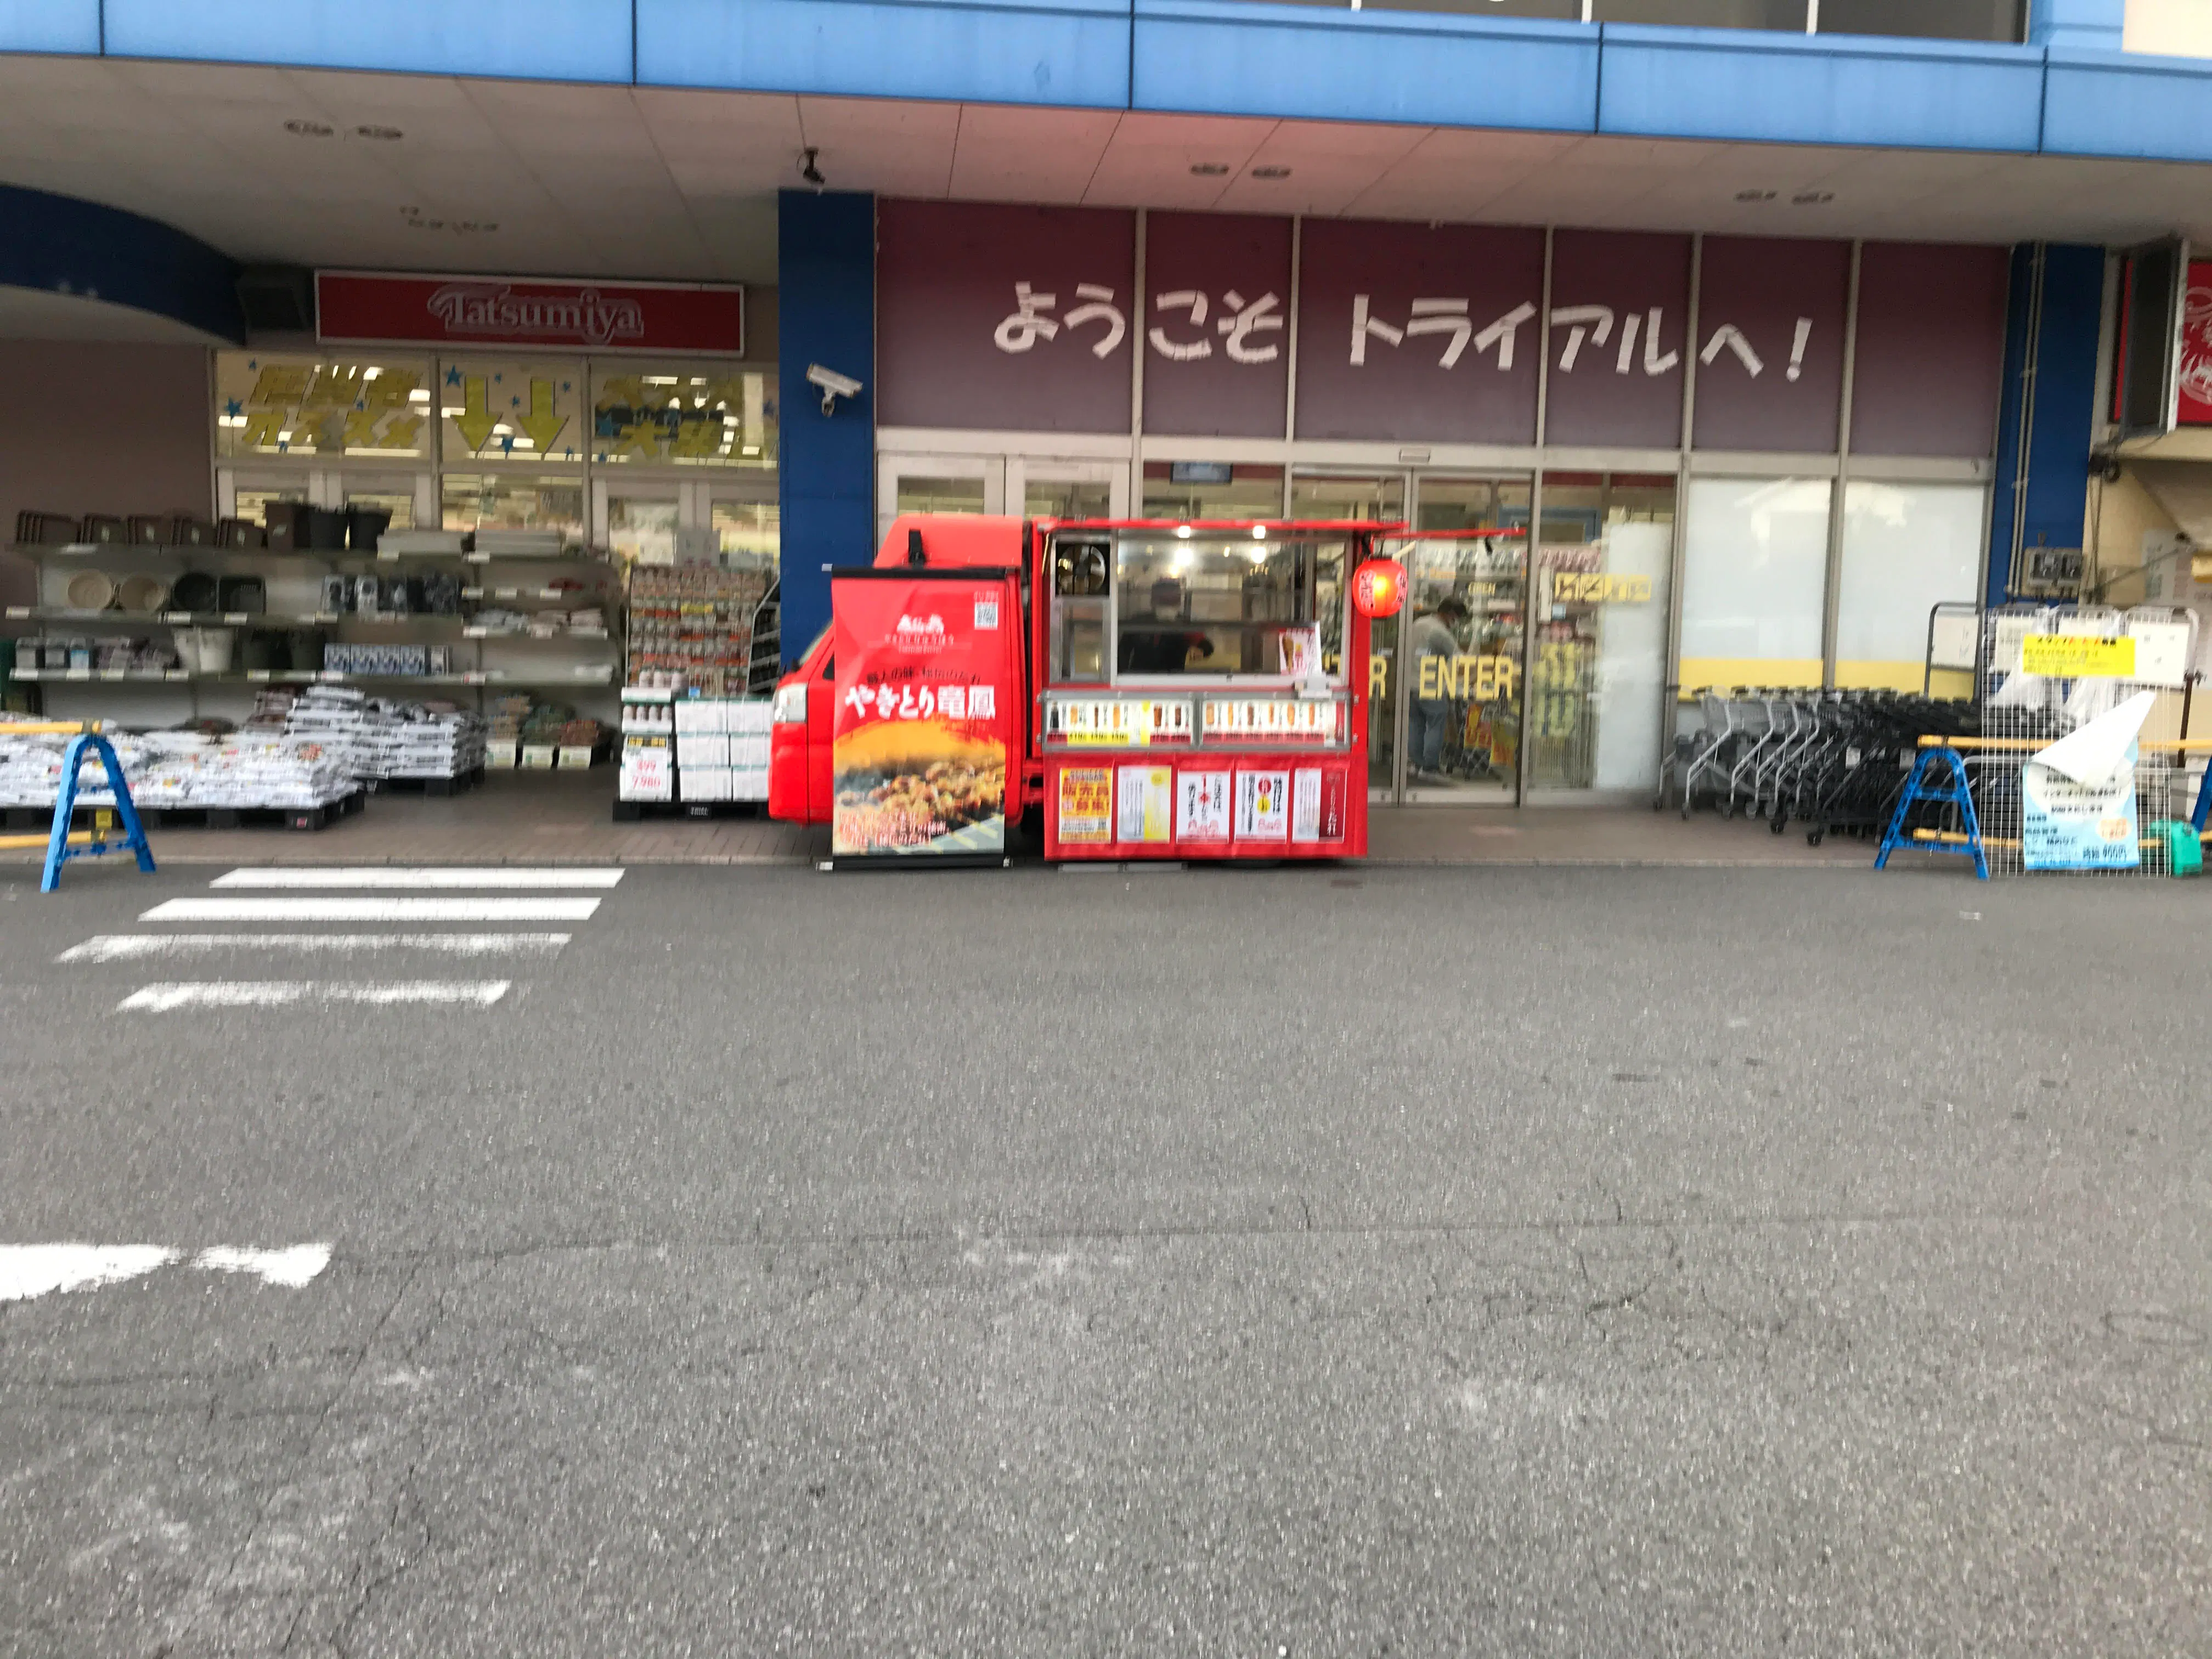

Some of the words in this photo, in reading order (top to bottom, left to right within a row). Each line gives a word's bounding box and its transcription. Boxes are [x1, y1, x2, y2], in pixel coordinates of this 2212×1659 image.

[427, 283, 645, 346] Tatsumiya
[994, 281, 1284, 364] ようこそ
[1419, 654, 1513, 702] ENTER
